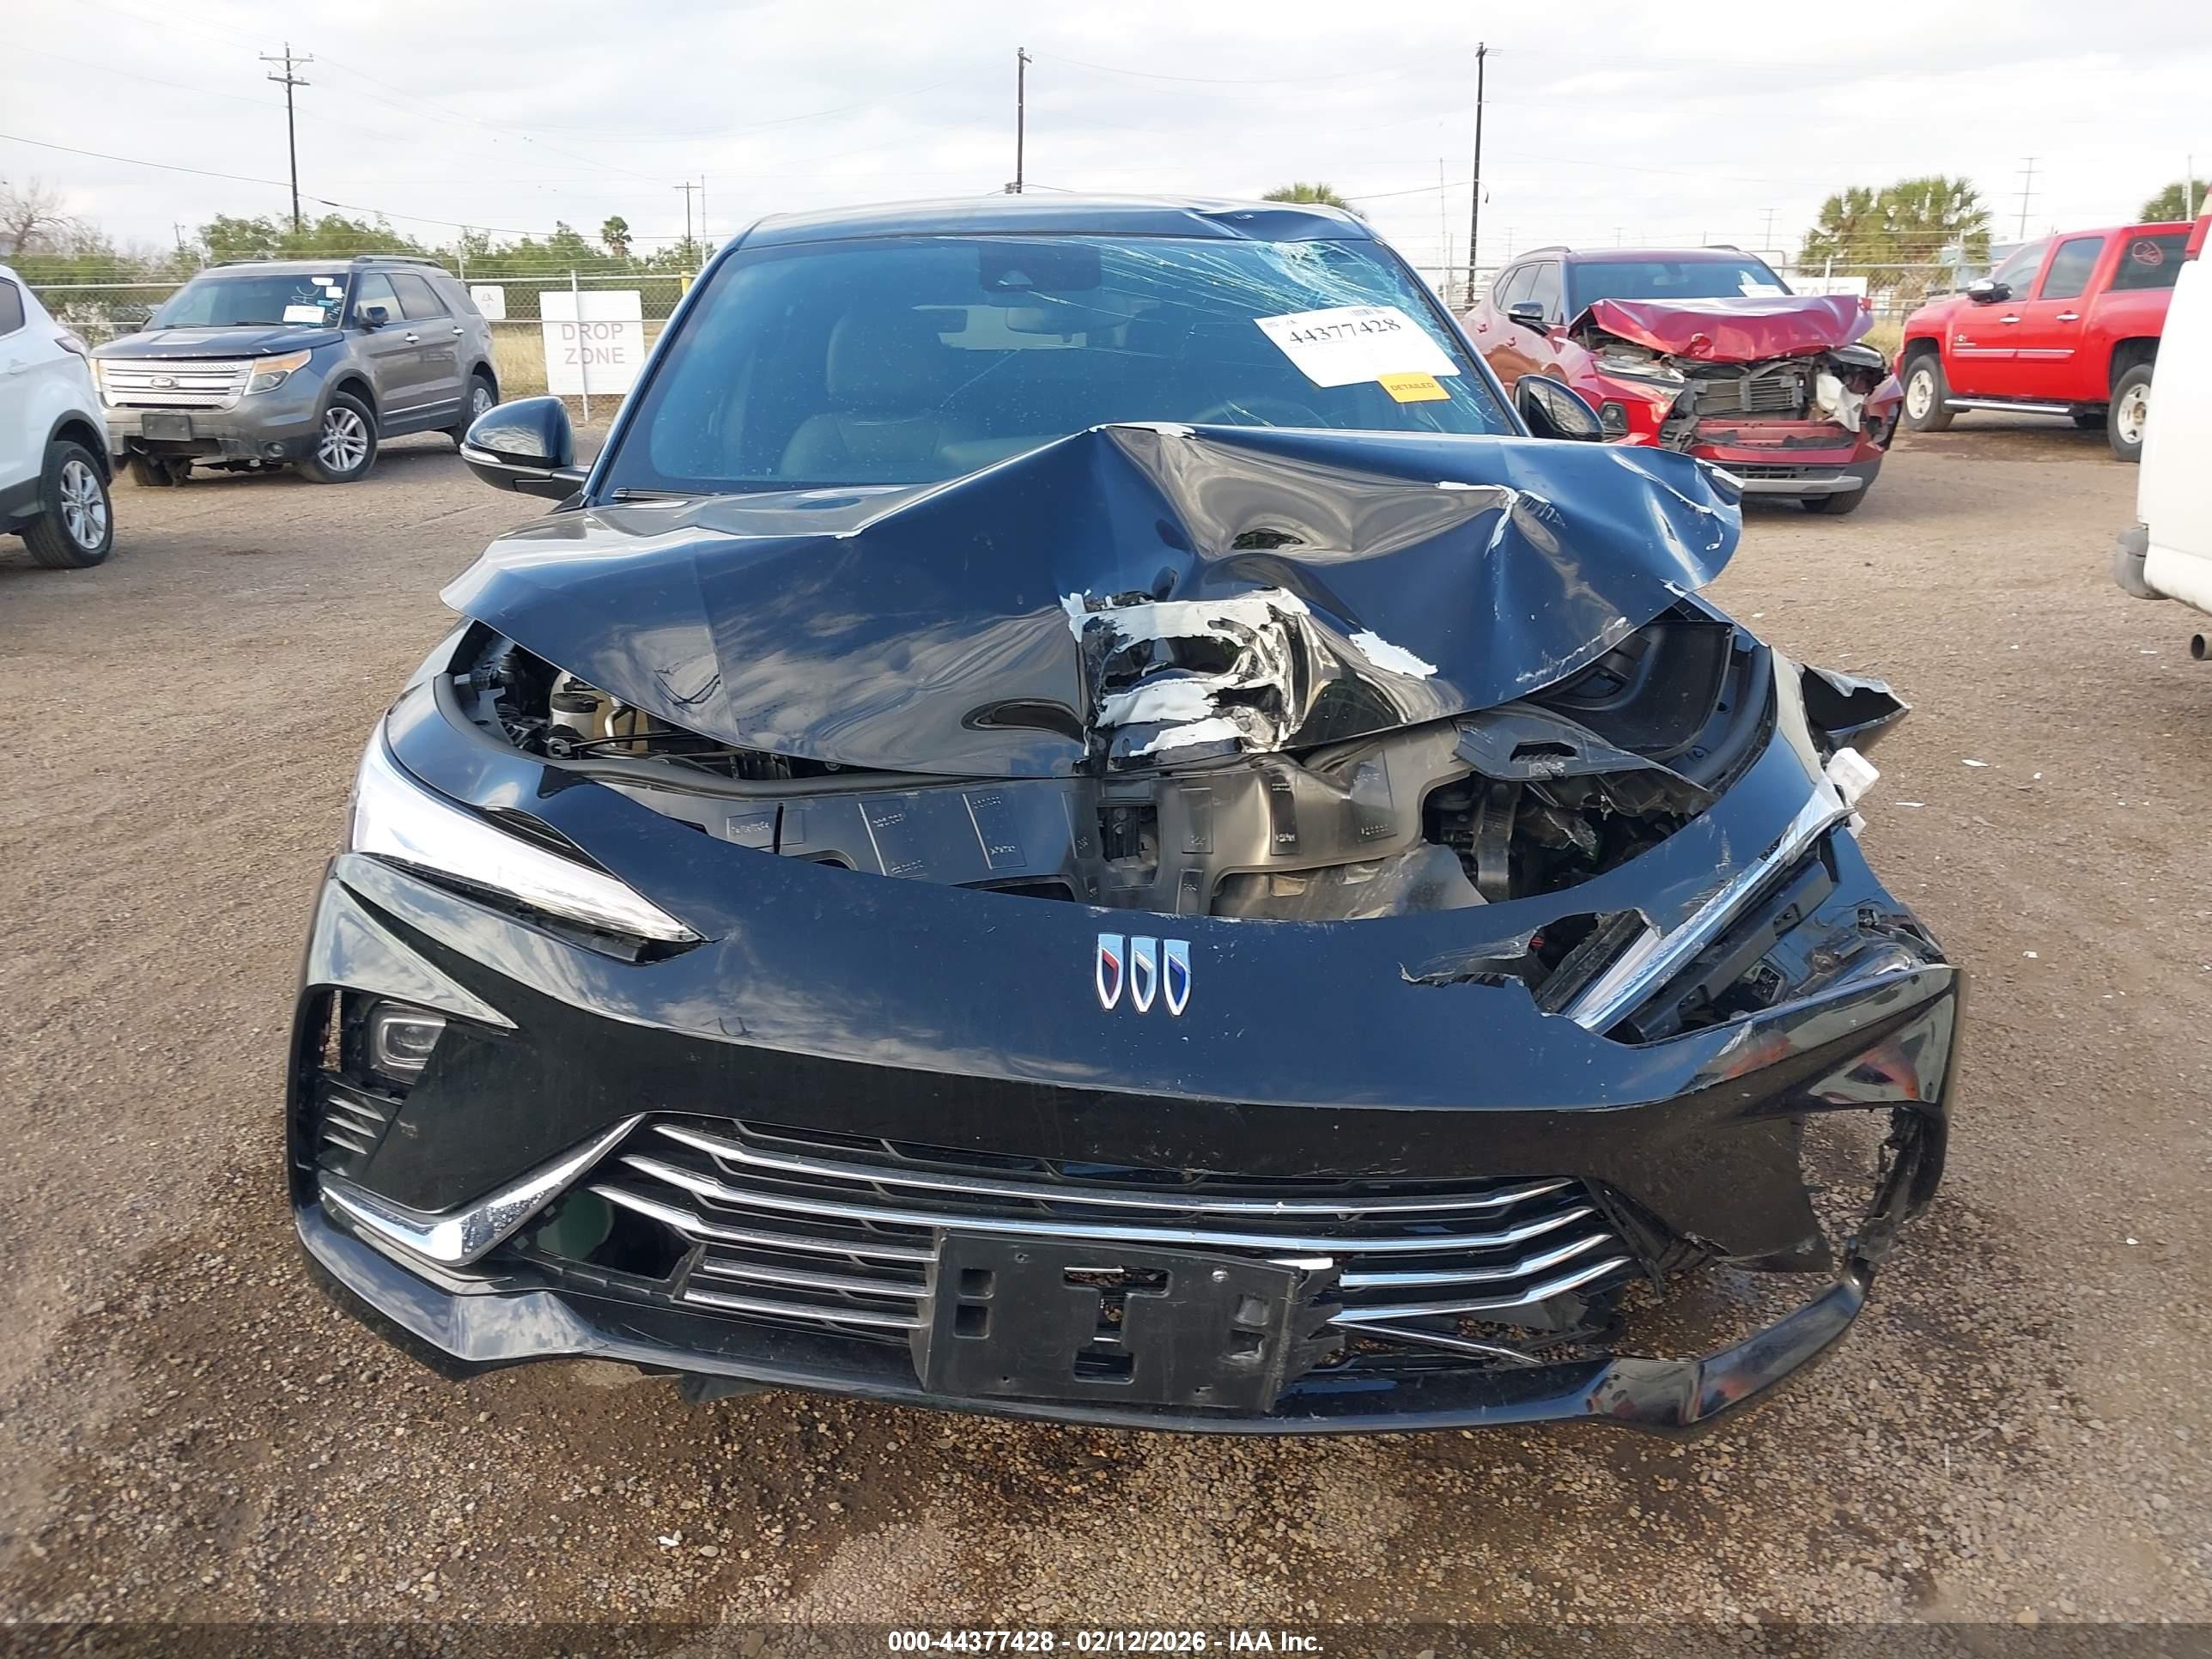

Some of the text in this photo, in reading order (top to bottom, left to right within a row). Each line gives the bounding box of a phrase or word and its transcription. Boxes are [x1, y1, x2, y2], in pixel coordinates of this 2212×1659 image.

[561, 323, 624, 341] DROP
[1289, 318, 1401, 343] 44377428
[564, 346, 626, 365] ZONE
[1390, 382, 1436, 392] DETAILED
